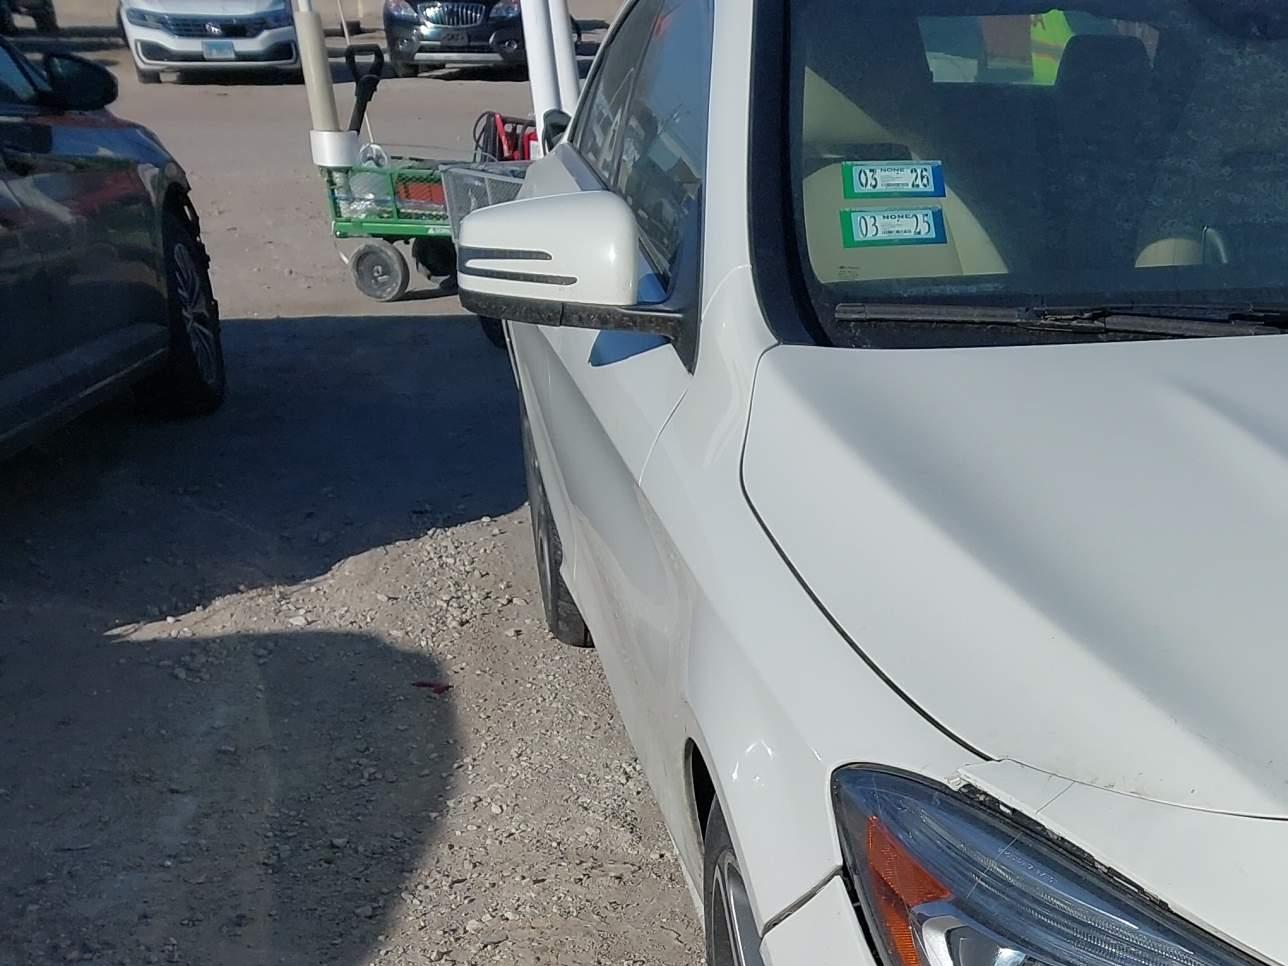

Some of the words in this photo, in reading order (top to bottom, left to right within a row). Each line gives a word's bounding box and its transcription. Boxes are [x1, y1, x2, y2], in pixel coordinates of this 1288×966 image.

[858, 167, 879, 189] 03
[910, 167, 930, 188] 26
[859, 214, 879, 238] 03
[911, 213, 931, 236] 25
